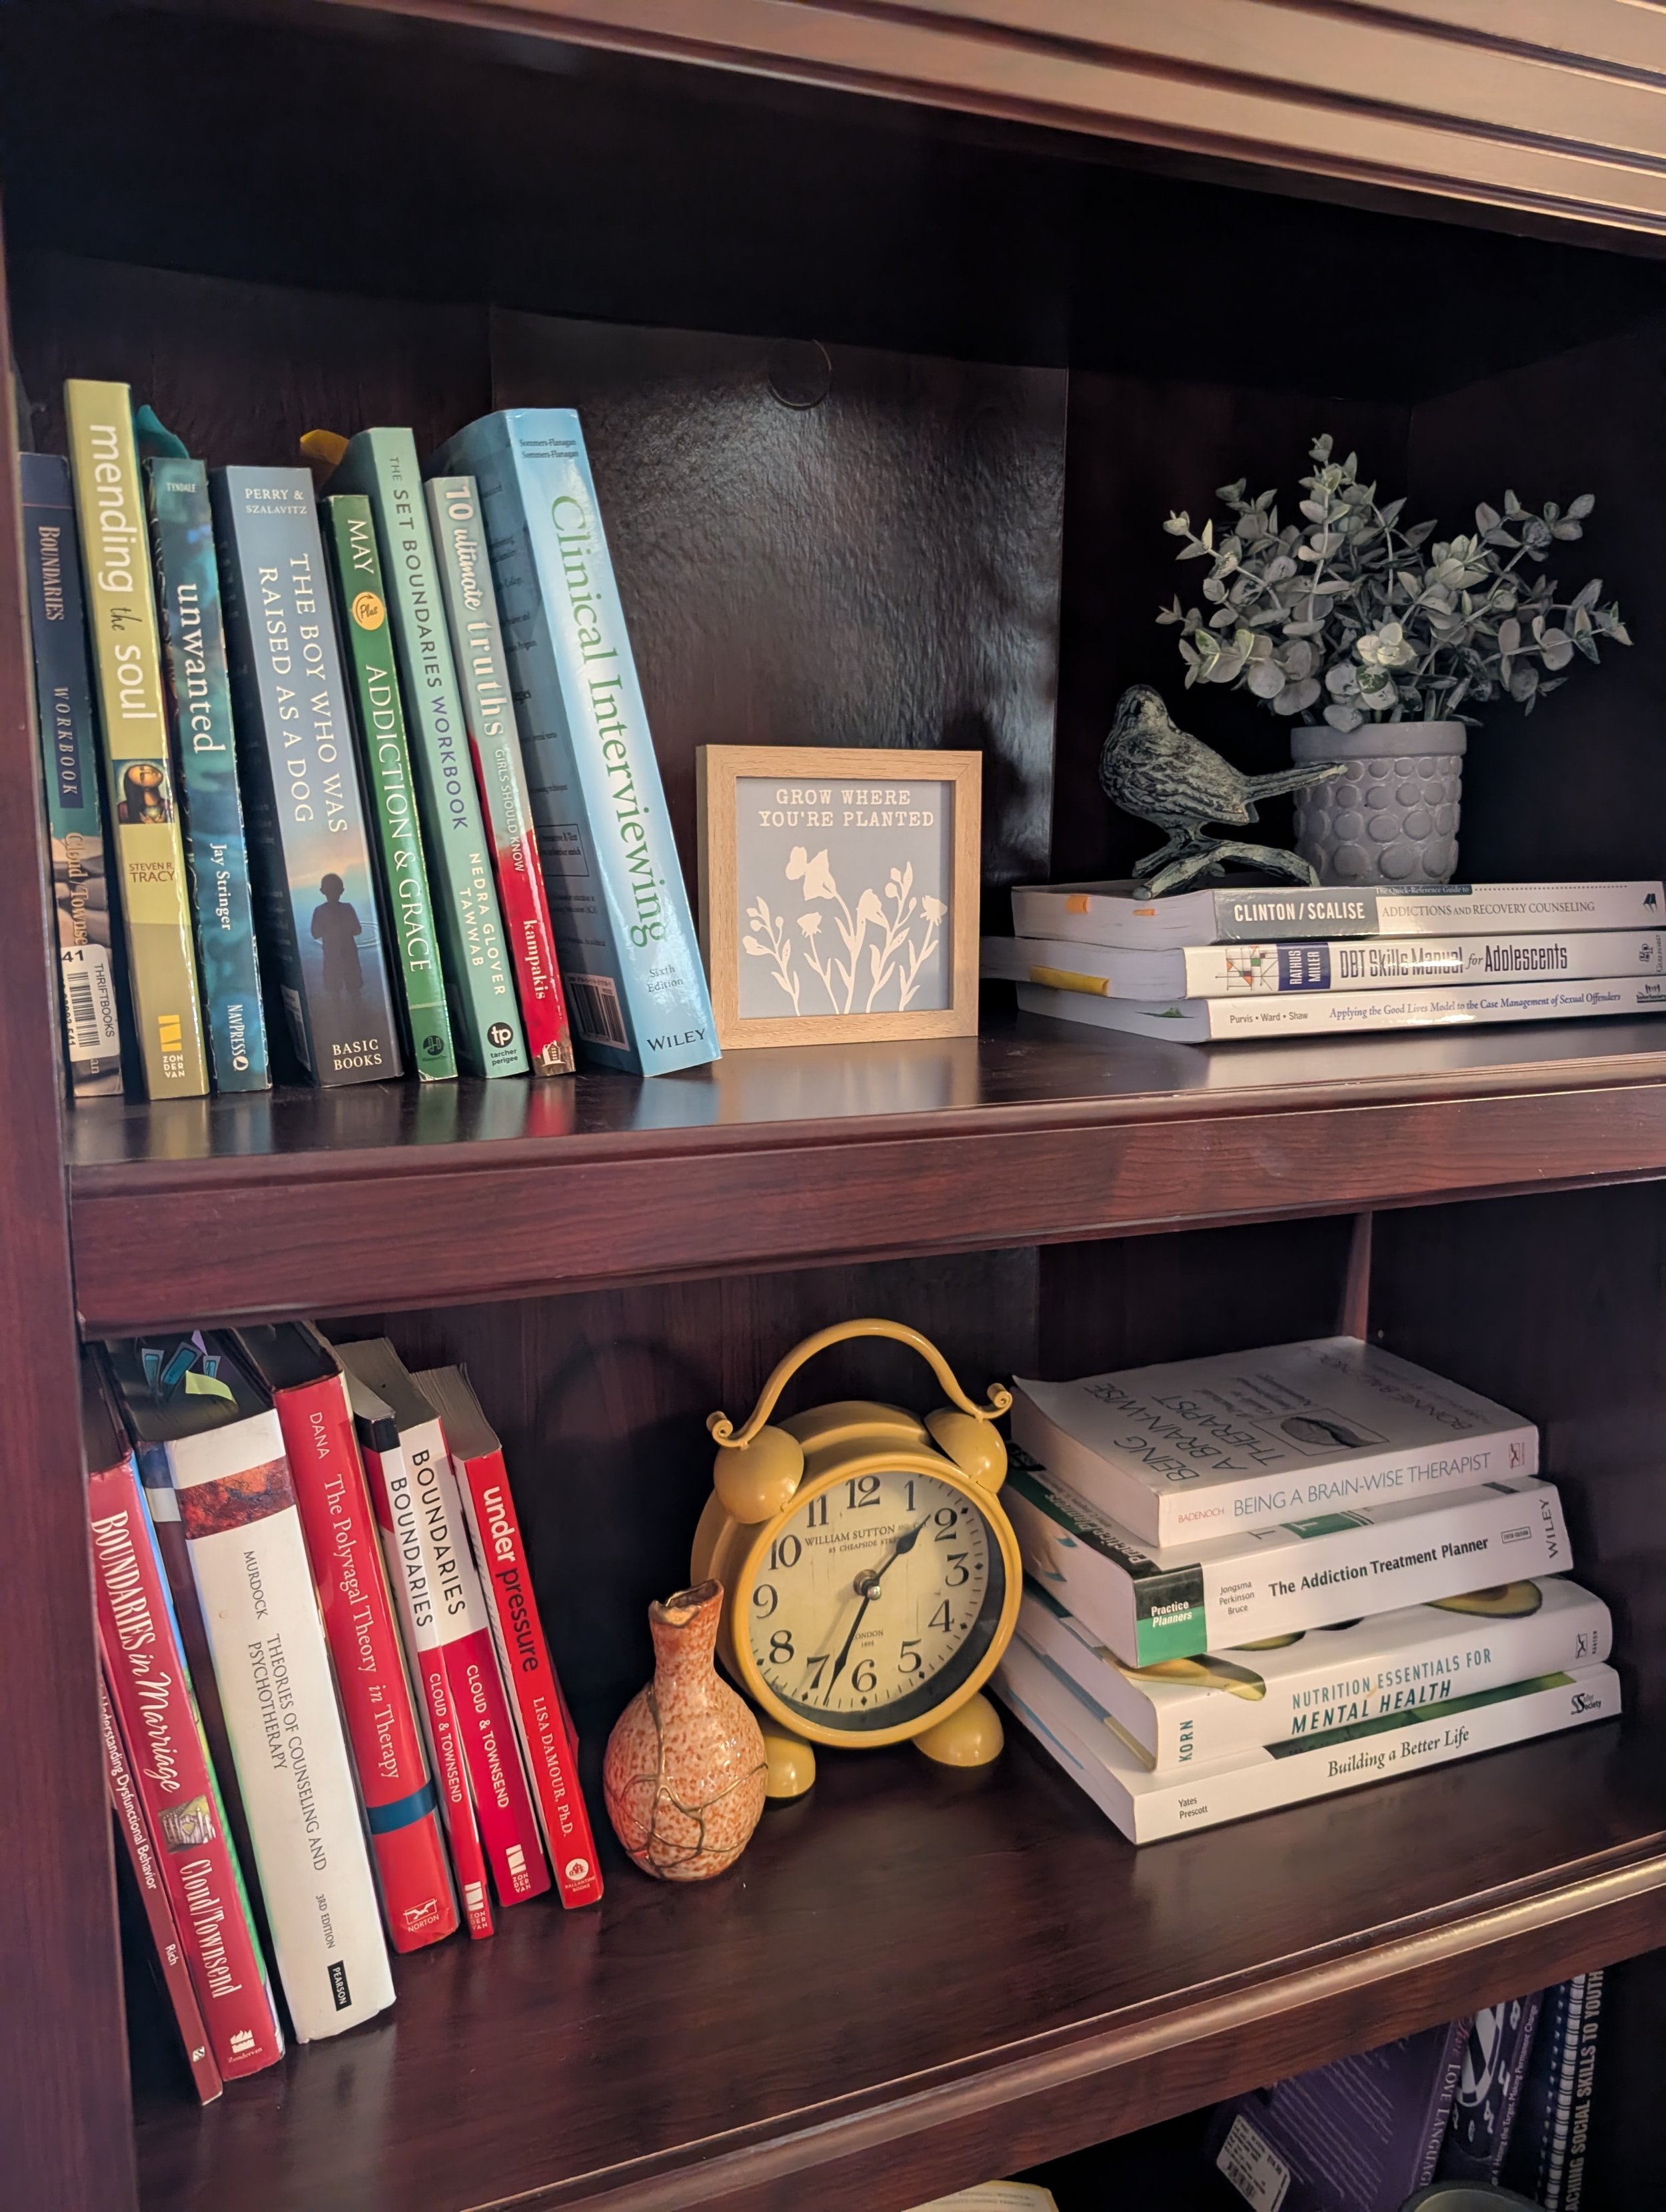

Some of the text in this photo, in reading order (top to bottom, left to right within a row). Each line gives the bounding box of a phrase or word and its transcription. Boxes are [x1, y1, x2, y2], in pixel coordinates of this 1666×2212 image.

[519, 438, 576, 448] Sommers-Flanagan
[522, 450, 579, 460] Sommers-Flanagan
[245, 488, 289, 501] PERRY
[246, 504, 308, 515] SZALAVITZ
[347, 519, 374, 575] MAY
[39, 526, 64, 621] BOUNDARIES
[90, 425, 158, 719] mending soul
[445, 486, 508, 736] 10 ultimate truths
[389, 456, 468, 831] THE SET BOUNDARIES WORKBOOK
[177, 583, 227, 752] unwanted
[259, 567, 315, 824] RAISED DOG
[290, 554, 348, 833] THE BOY WHO WAS
[551, 495, 619, 665] Clinical
[588, 674, 666, 948] Interviewing
[494, 748, 524, 873] GIRLS SHOULD KNOW
[776, 790, 910, 806] GROW WHERE
[365, 664, 432, 973] ADDICTION GRACE
[758, 811, 934, 827] YOU'RE PLANTED
[129, 870, 175, 883] TRACY
[209, 843, 232, 931] Jay Stringer
[469, 853, 504, 995] NEDRA GLOVER
[1234, 902, 1365, 921] CLINTON SCALISE
[1382, 901, 1595, 917] ADDICTIONS RECOVERY COUNSELING
[458, 887, 484, 967] TAWWAB
[522, 919, 548, 1000] kampakis
[649, 965, 676, 979] Sixth
[1289, 950, 1302, 985] RATHUS
[1307, 951, 1319, 983] MILLER
[1339, 943, 1567, 978] DBT for Adolescents
[95, 963, 115, 1037] THRIFTBOOKS
[646, 976, 684, 993] Edition
[1230, 1011, 1308, 1024] Purvis Ward Shaw
[1329, 991, 1621, 1019] Applying Good Lives Model Case Management Sexual Offenders
[227, 1004, 245, 1057] NAVPRESS
[332, 1038, 379, 1057] BASIC
[646, 1028, 707, 1052] WILEY
[333, 1052, 383, 1071] BOOKS
[490, 1048, 518, 1059] tarcher
[491, 1055, 518, 1066] perigee
[309, 1412, 331, 1459] DANA
[1114, 1436, 1200, 1482] BEING
[846, 1475, 880, 1510] 12
[904, 1479, 916, 1511] 1
[1178, 1452, 1491, 1523] BADENOCH BEING BRAIN-WISE THERAPIST
[412, 1449, 465, 1616] BOUNDARIES
[805, 1525, 895, 1546] WILLIAM SUTTON
[934, 1508, 957, 1542] 2
[1539, 1498, 1559, 1558] WILEY
[390, 1476, 432, 1627] BOUNDARIES
[768, 1534, 802, 1570] 10
[840, 1540, 877, 1552] CHEAPSIDE
[482, 1485, 538, 1673] under pressure
[945, 1552, 969, 1586] 3
[1269, 1537, 1489, 1597] The Addiction Treatment Planner
[244, 1550, 269, 1620] MURDOCK
[753, 1584, 778, 1618] 9
[1219, 1591, 1255, 1606] Perkinson
[1220, 1581, 1252, 1594] Jongsma
[324, 1473, 399, 1779] The Polyvagal Theory Therapy
[928, 1599, 954, 1632] 4
[1151, 1600, 1190, 1618] Practice
[1152, 1610, 1193, 1628] Planners
[1227, 1604, 1249, 1615] Bruce
[91, 1510, 181, 1794] BOUNDARIES Marriage
[769, 1630, 794, 1664] 8
[898, 1638, 922, 1673] 5
[806, 1654, 830, 1690] 7
[852, 1659, 876, 1692] 6
[1291, 1648, 1493, 1711] NUTRITION ESSENTIALS FOR
[248, 1640, 288, 1770] PSYCHOTHERAPY
[533, 1697, 550, 1732] LISA
[1290, 1680, 1452, 1736] MENTAL HEALTH
[267, 1632, 321, 1834] THEORIES COUNSELING
[429, 1673, 461, 1803] CLOUD TOWNSEND
[466, 1665, 510, 1808] CLOUD TOWNSEND
[1178, 1719, 1194, 1763] KORN
[1327, 1726, 1469, 1777] Building Better Life
[1178, 1796, 1198, 1810] Yates
[1178, 1805, 1209, 1821] Prescott
[136, 1844, 157, 1890] Behavior
[572, 1882, 590, 1892] BOOKS
[315, 1894, 337, 1949] 3RD EDITION
[408, 1914, 440, 1932] NORTON
[164, 1943, 177, 1966] Rich
[332, 1967, 348, 2005] PEARSON
[227, 2046, 263, 2064] Zondervan
[1571, 1970, 1604, 2154] SOCIAL SKILLS TO YOUTH
[1440, 2063, 1461, 2101] LOVE
